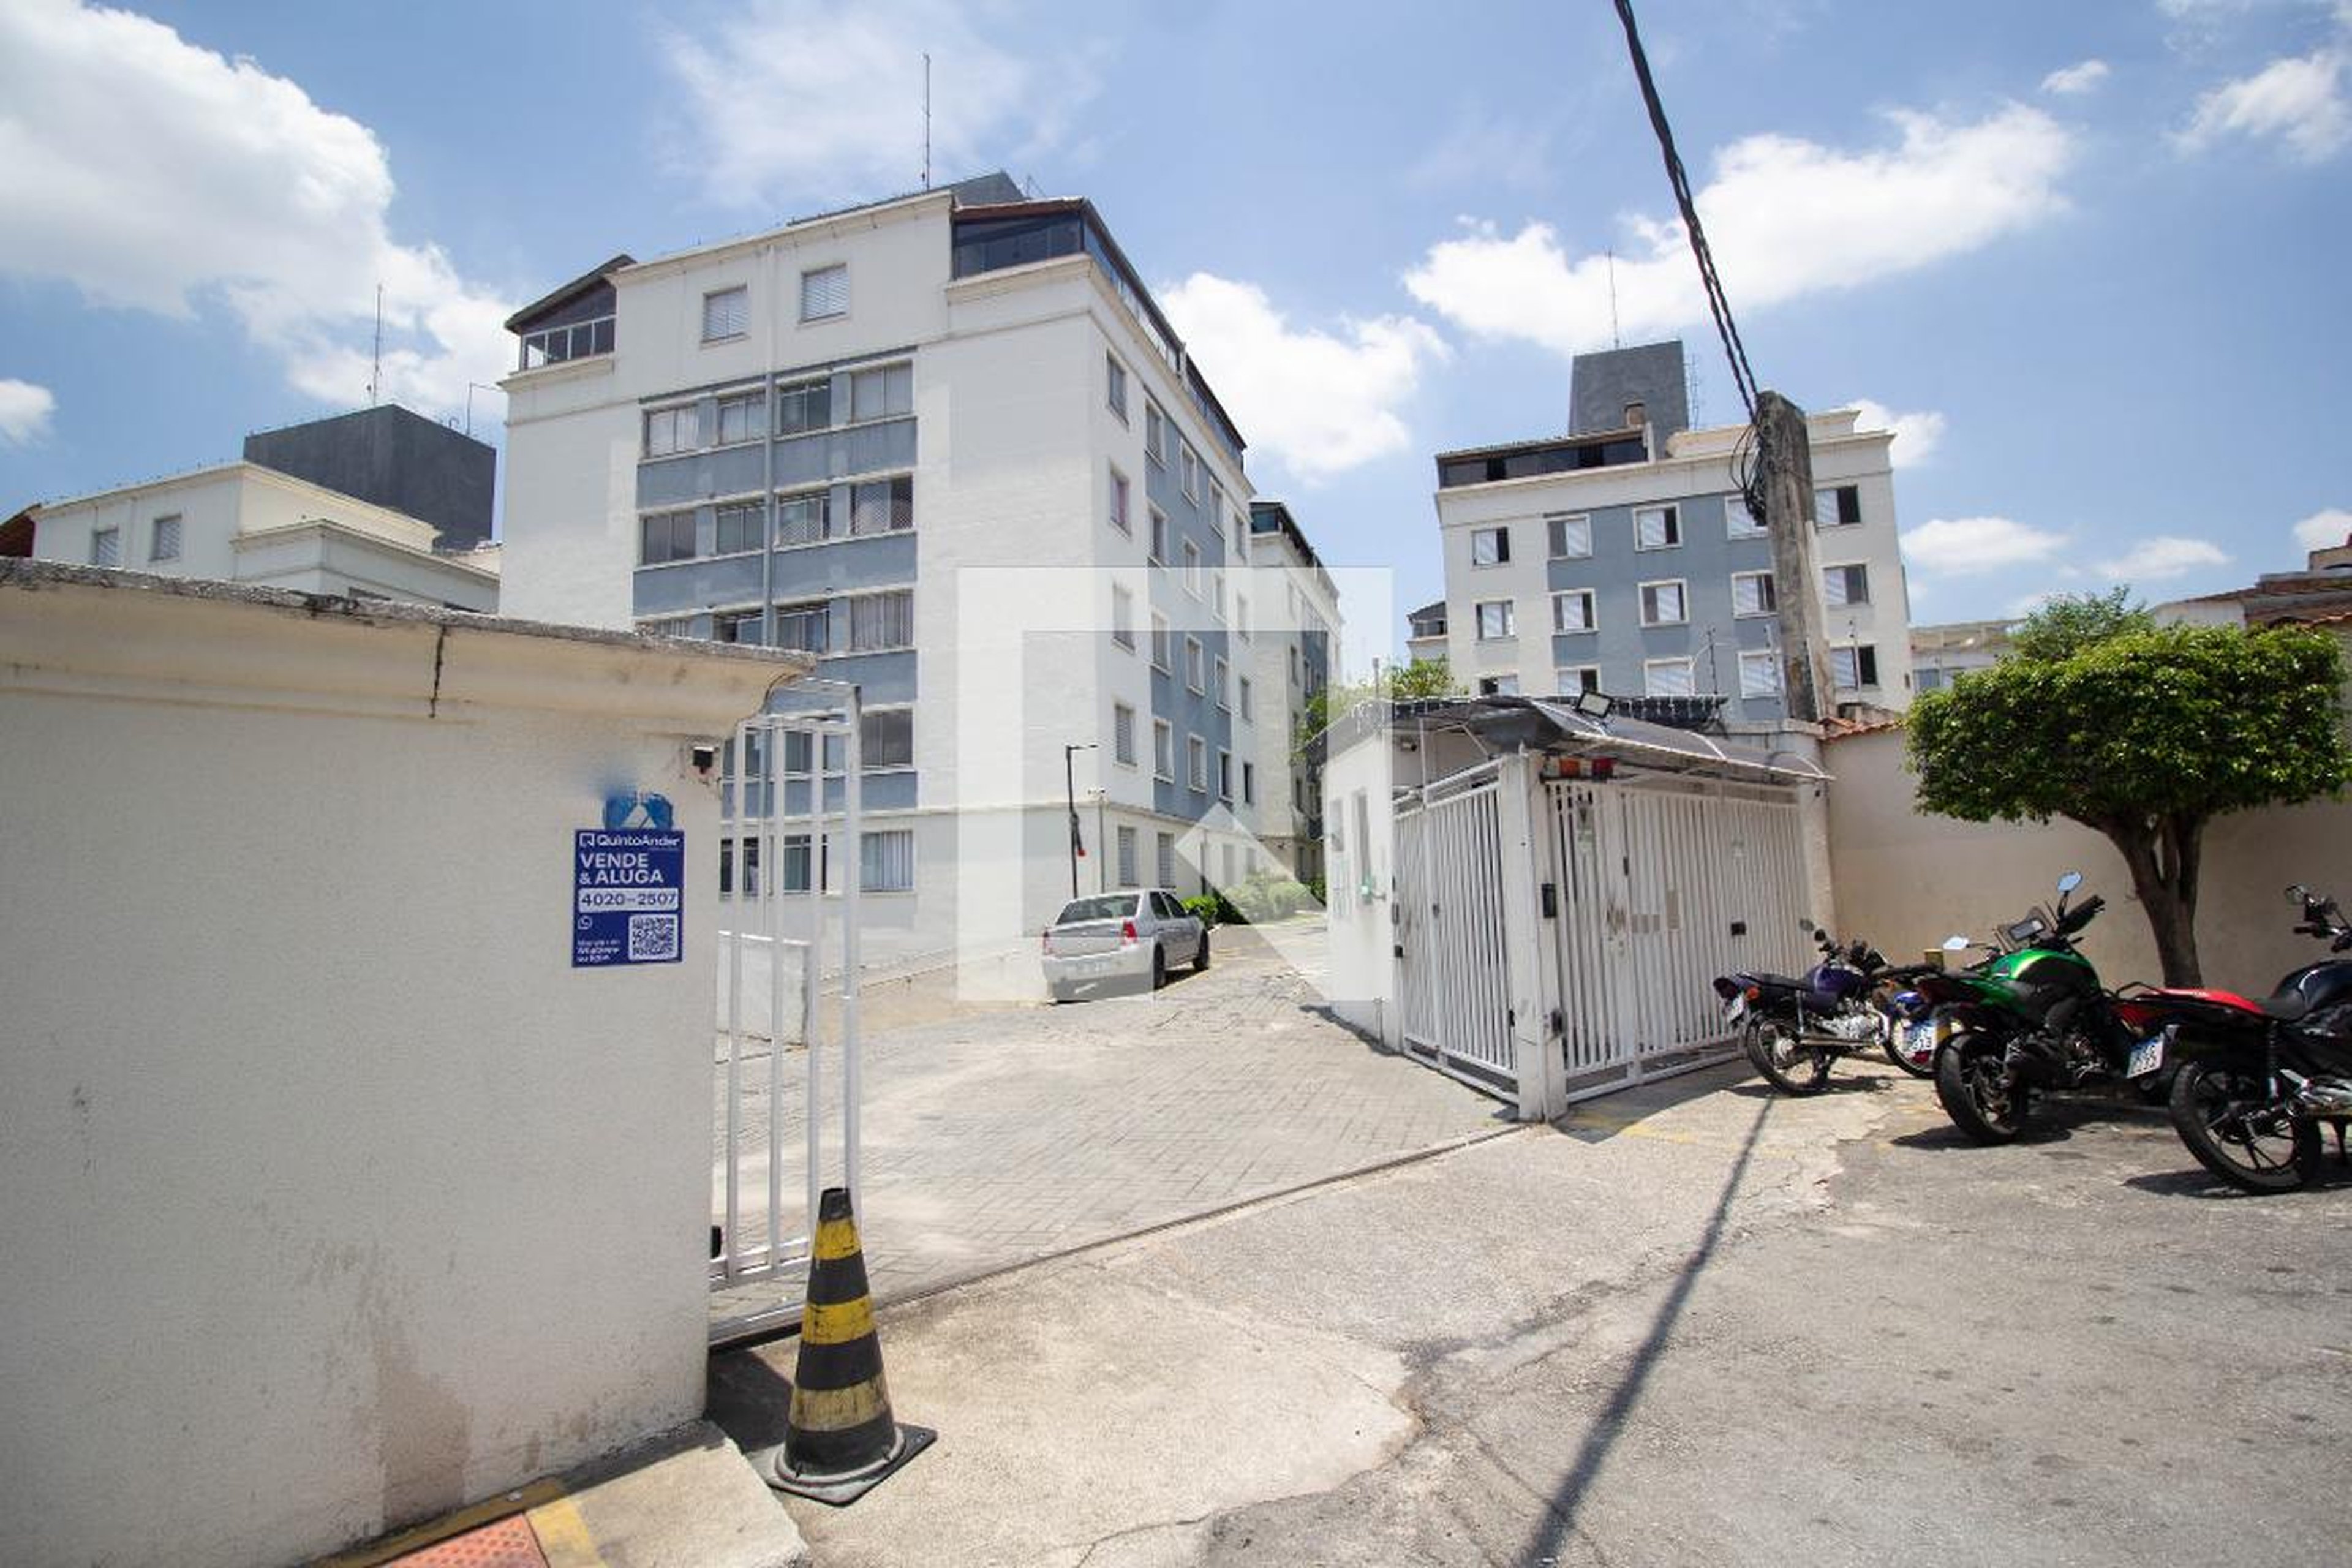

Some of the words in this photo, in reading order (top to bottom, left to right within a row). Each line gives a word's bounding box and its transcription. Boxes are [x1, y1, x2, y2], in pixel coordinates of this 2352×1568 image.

[579, 853, 649, 868] VENDE
[579, 873, 592, 885] &
[595, 869, 663, 884] ALUGA
[582, 892, 677, 907] 4020-2507
